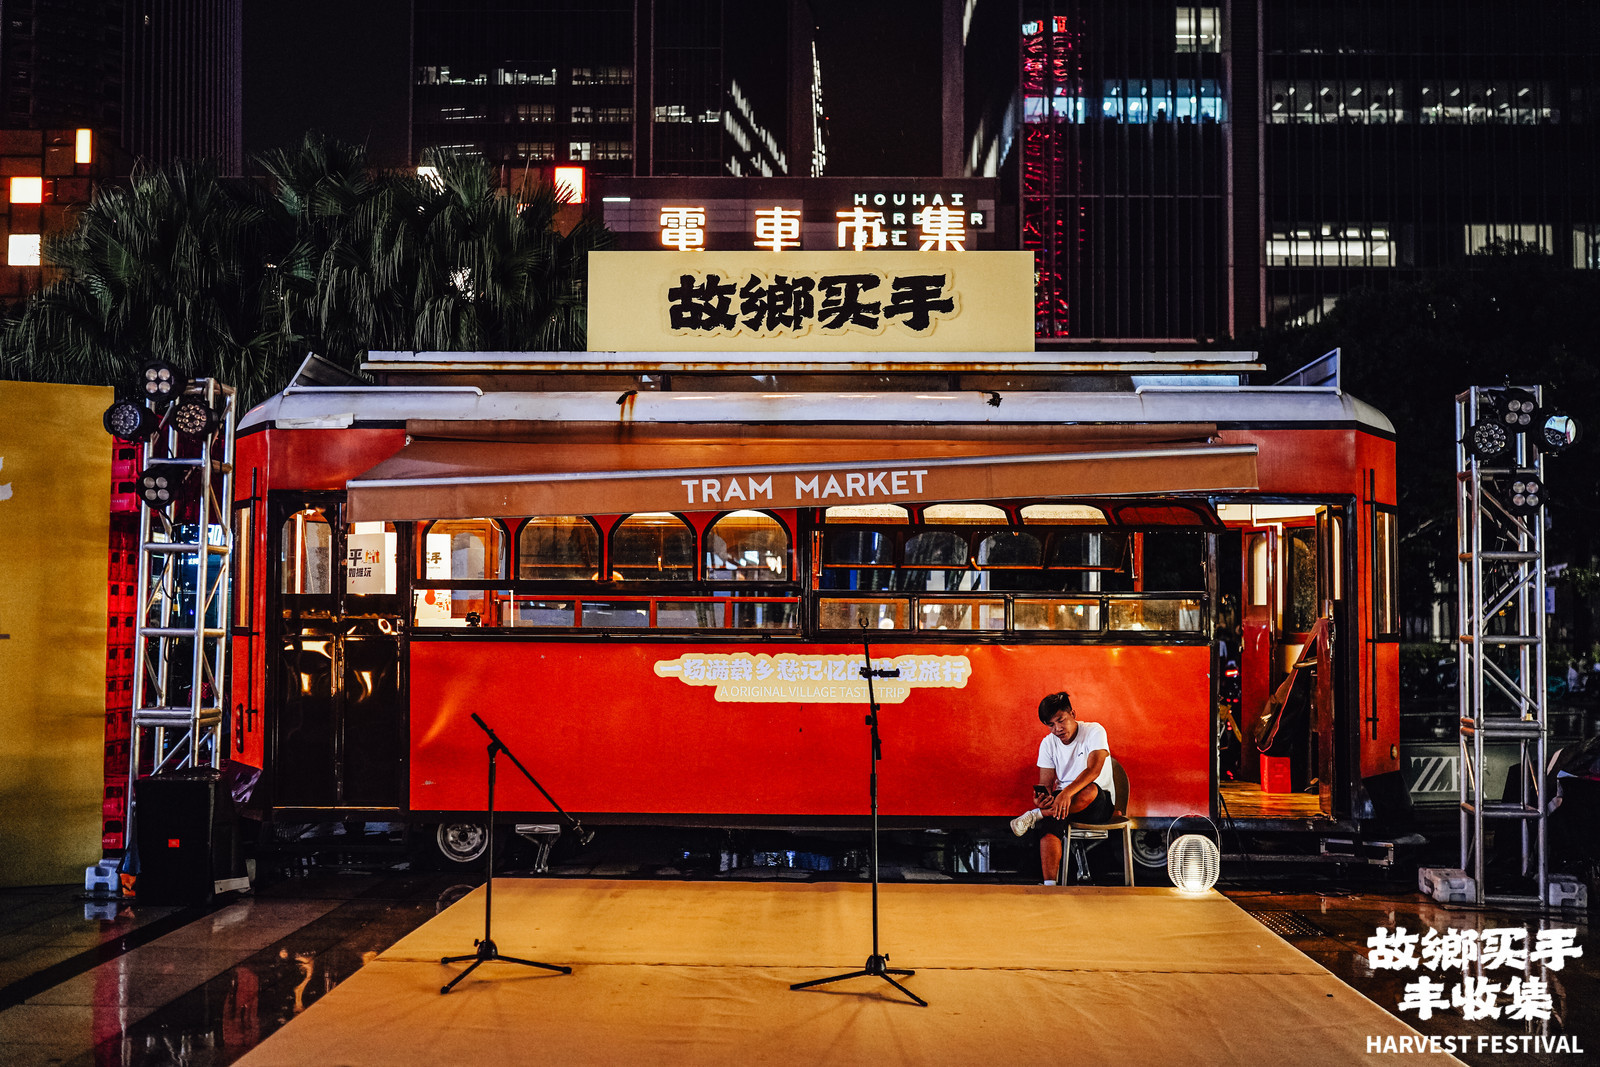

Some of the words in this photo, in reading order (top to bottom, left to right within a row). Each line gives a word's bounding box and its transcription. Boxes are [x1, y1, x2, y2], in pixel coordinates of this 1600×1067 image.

[854, 193, 964, 206] HOUHAI
[660, 206, 966, 251] 電車市集
[681, 475, 773, 504] TRAM
[795, 469, 928, 499] MARKET
[720, 686, 729, 697] A
[731, 686, 787, 697] ORIGINAL
[788, 686, 837, 698] VILLAGE
[839, 686, 876, 698] TAST
[878, 687, 905, 698] TRIP
